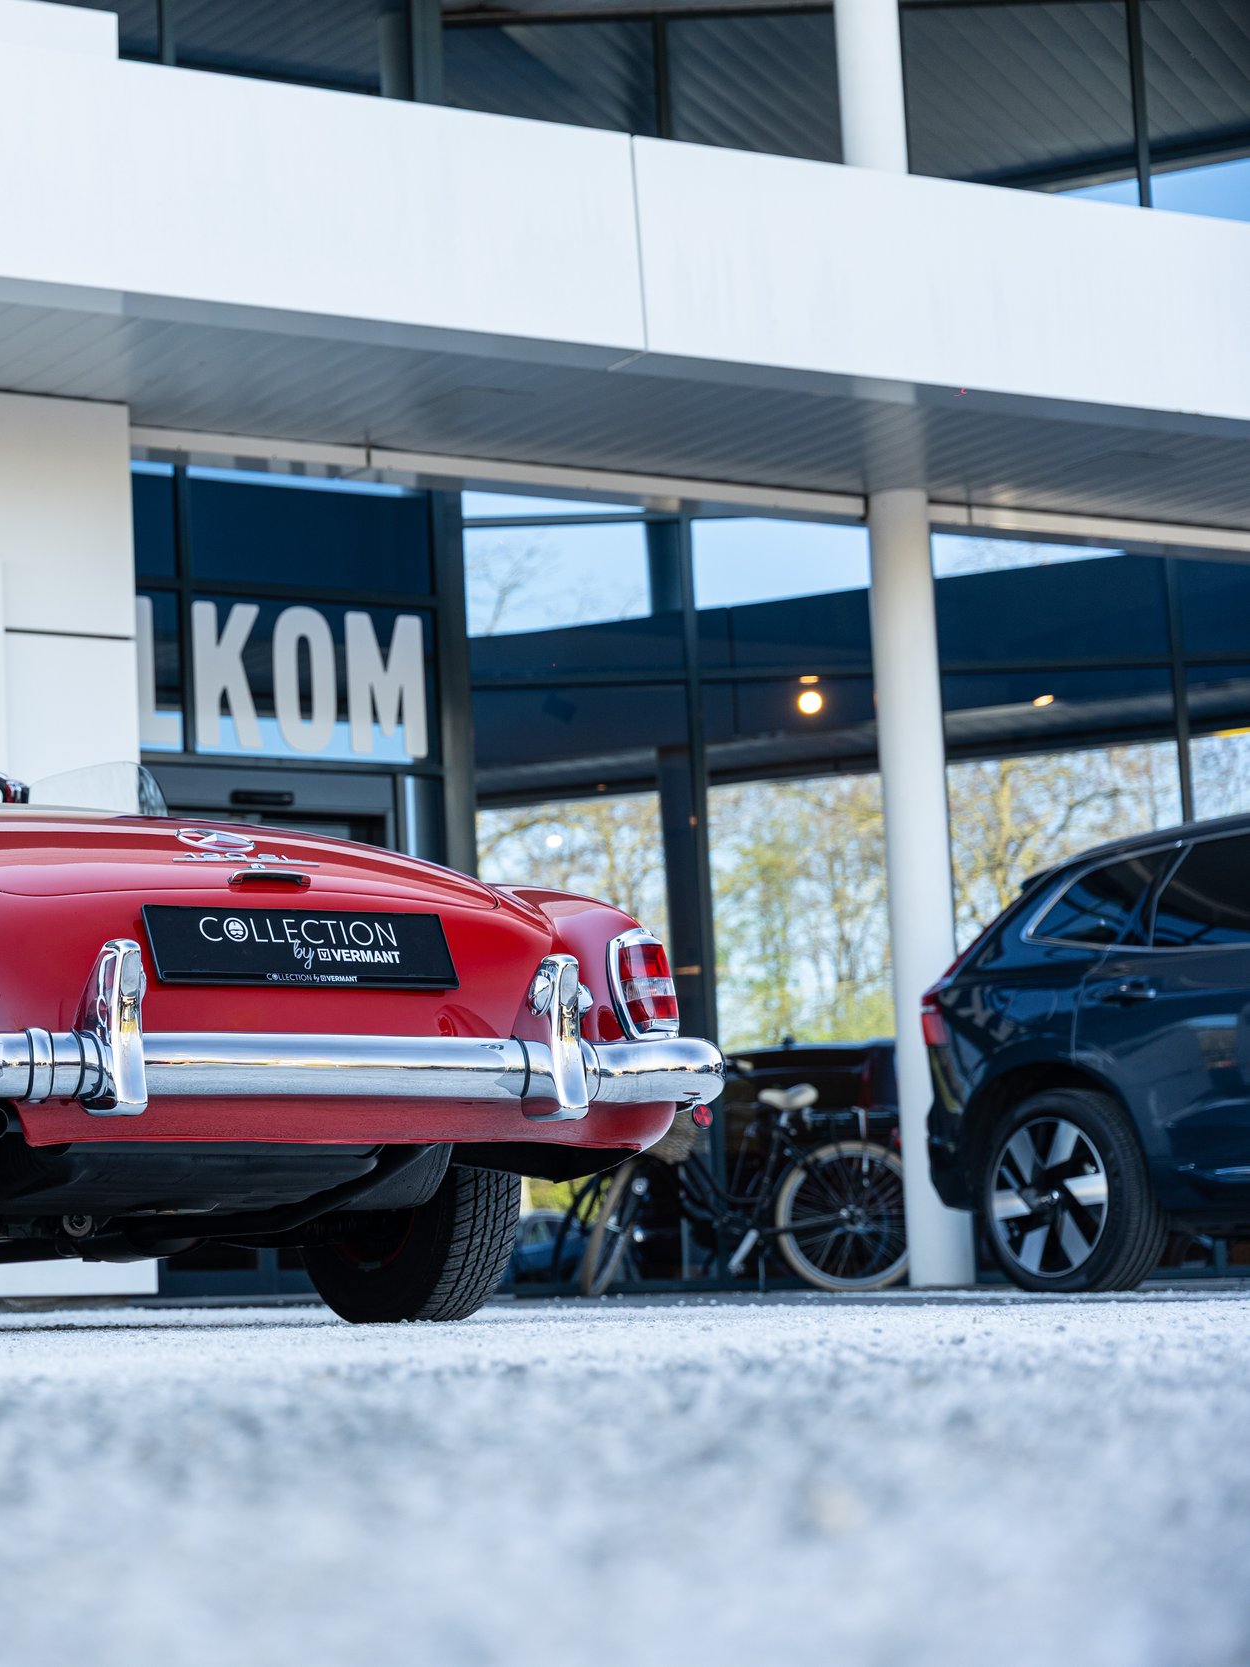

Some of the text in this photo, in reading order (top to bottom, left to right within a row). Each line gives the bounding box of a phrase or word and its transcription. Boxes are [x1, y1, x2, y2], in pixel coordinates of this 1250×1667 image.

[199, 916, 398, 947] COLLECTION
[293, 939, 315, 970] by
[331, 948, 400, 964] VERMANT
[266, 973, 313, 981] COLLECTION
[326, 975, 358, 983] VERMANT
